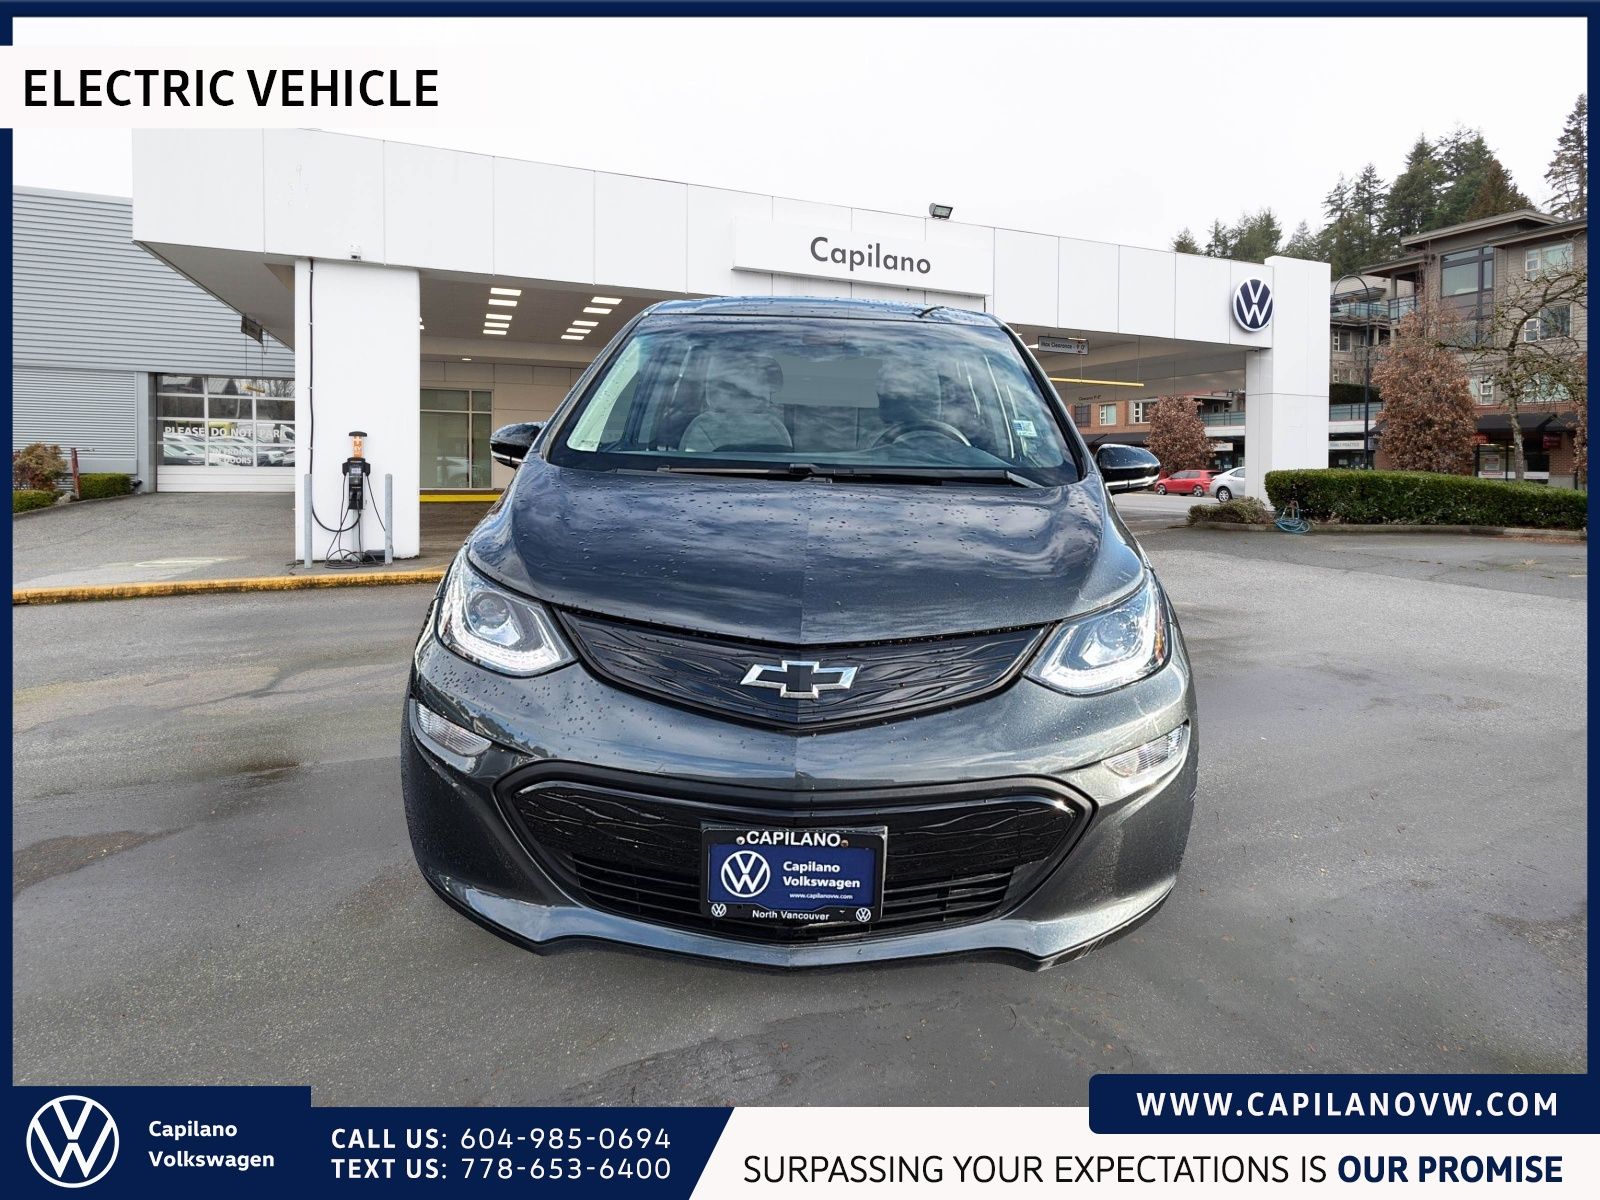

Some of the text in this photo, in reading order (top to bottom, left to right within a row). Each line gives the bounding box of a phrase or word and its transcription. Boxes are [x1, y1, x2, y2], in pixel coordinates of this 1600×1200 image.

[810, 236, 931, 274] Capilano
[1233, 278, 1273, 331] VW
[1051, 341, 1072, 350] Clearance
[164, 426, 205, 436] PLEASE
[211, 427, 227, 437] DO
[231, 428, 253, 438] NOT
[746, 831, 841, 847] CAPILANO
[721, 850, 771, 898] VW
[783, 861, 841, 874] Capilano
[783, 876, 860, 890] Volkswagen
[789, 892, 853, 900] www.capilanovw.com
[752, 910, 829, 920] North Vancouver
